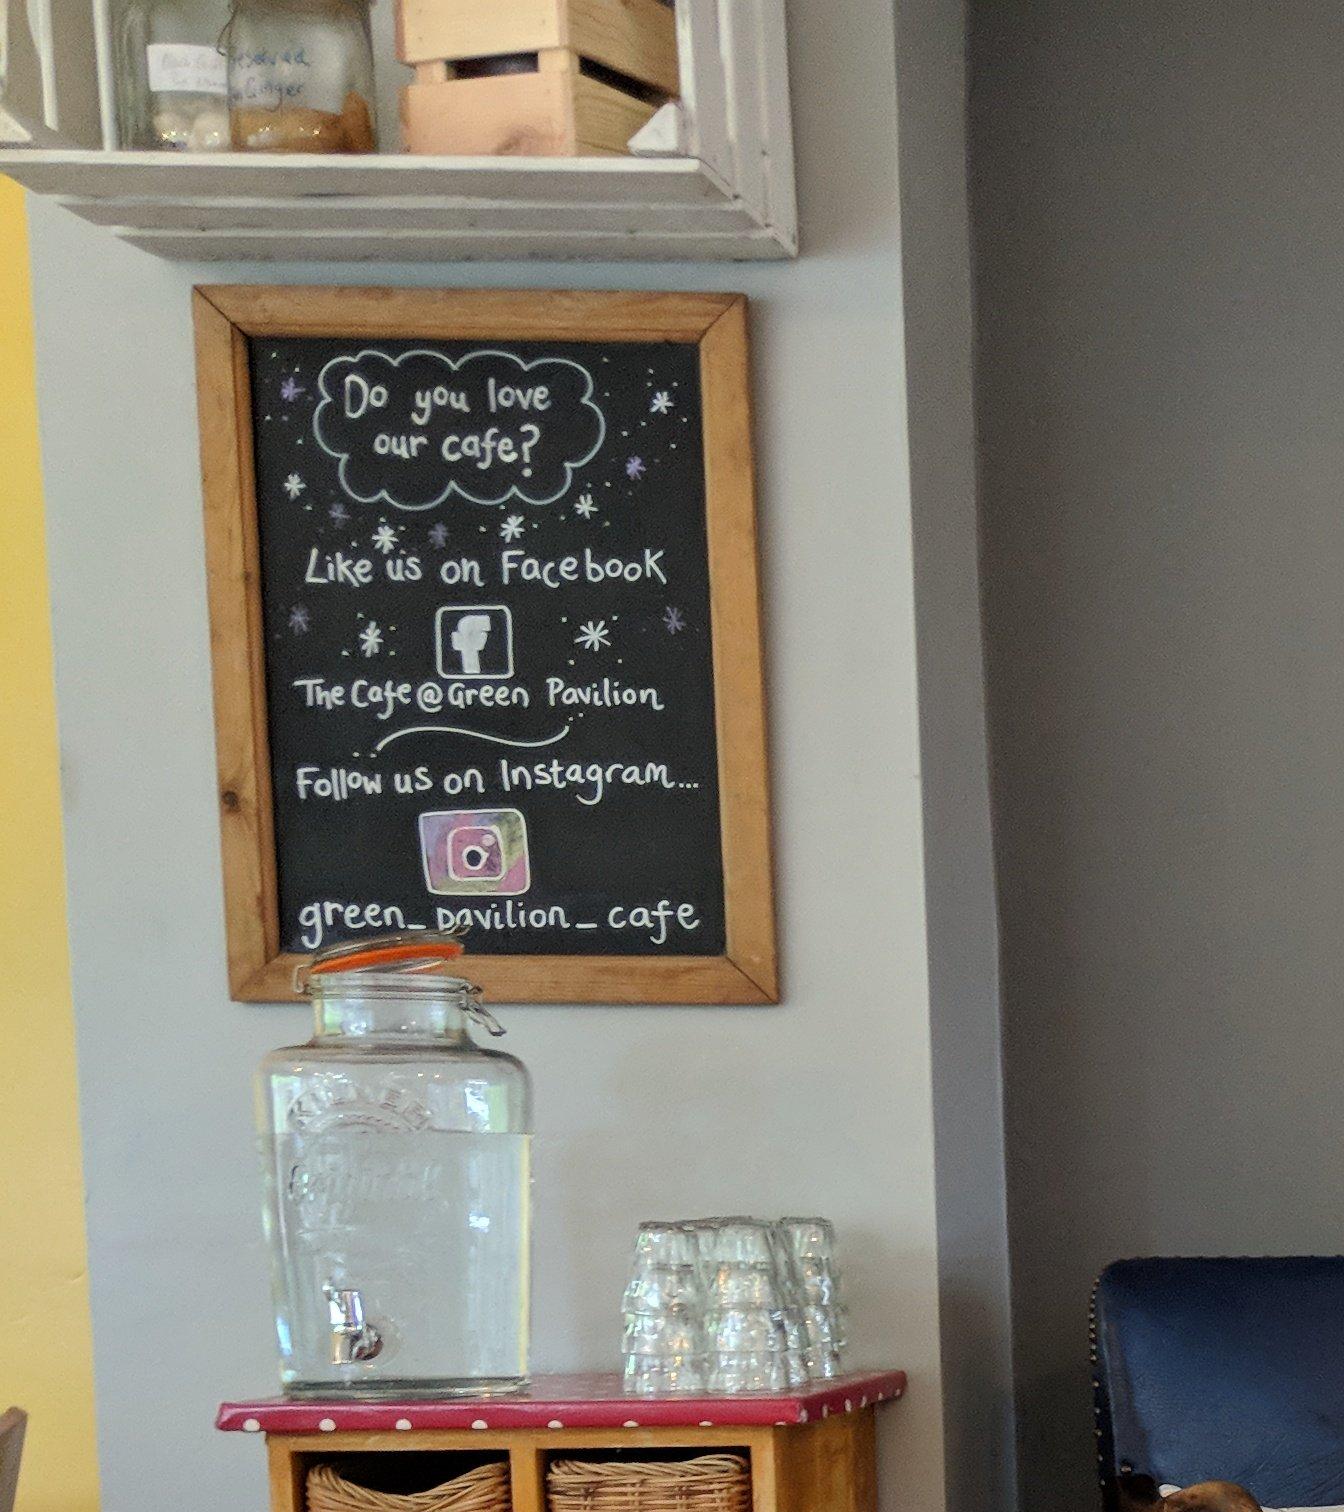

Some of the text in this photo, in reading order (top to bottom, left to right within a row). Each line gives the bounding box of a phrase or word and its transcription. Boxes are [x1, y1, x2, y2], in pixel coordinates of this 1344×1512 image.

[343, 372, 552, 426] Do you love
[373, 422, 541, 478] our cafe?
[304, 546, 668, 589] Like us on Facebook
[545, 676, 665, 712] Pavilion
[295, 765, 383, 802] Follow
[393, 765, 434, 794] us
[442, 767, 486, 795] on
